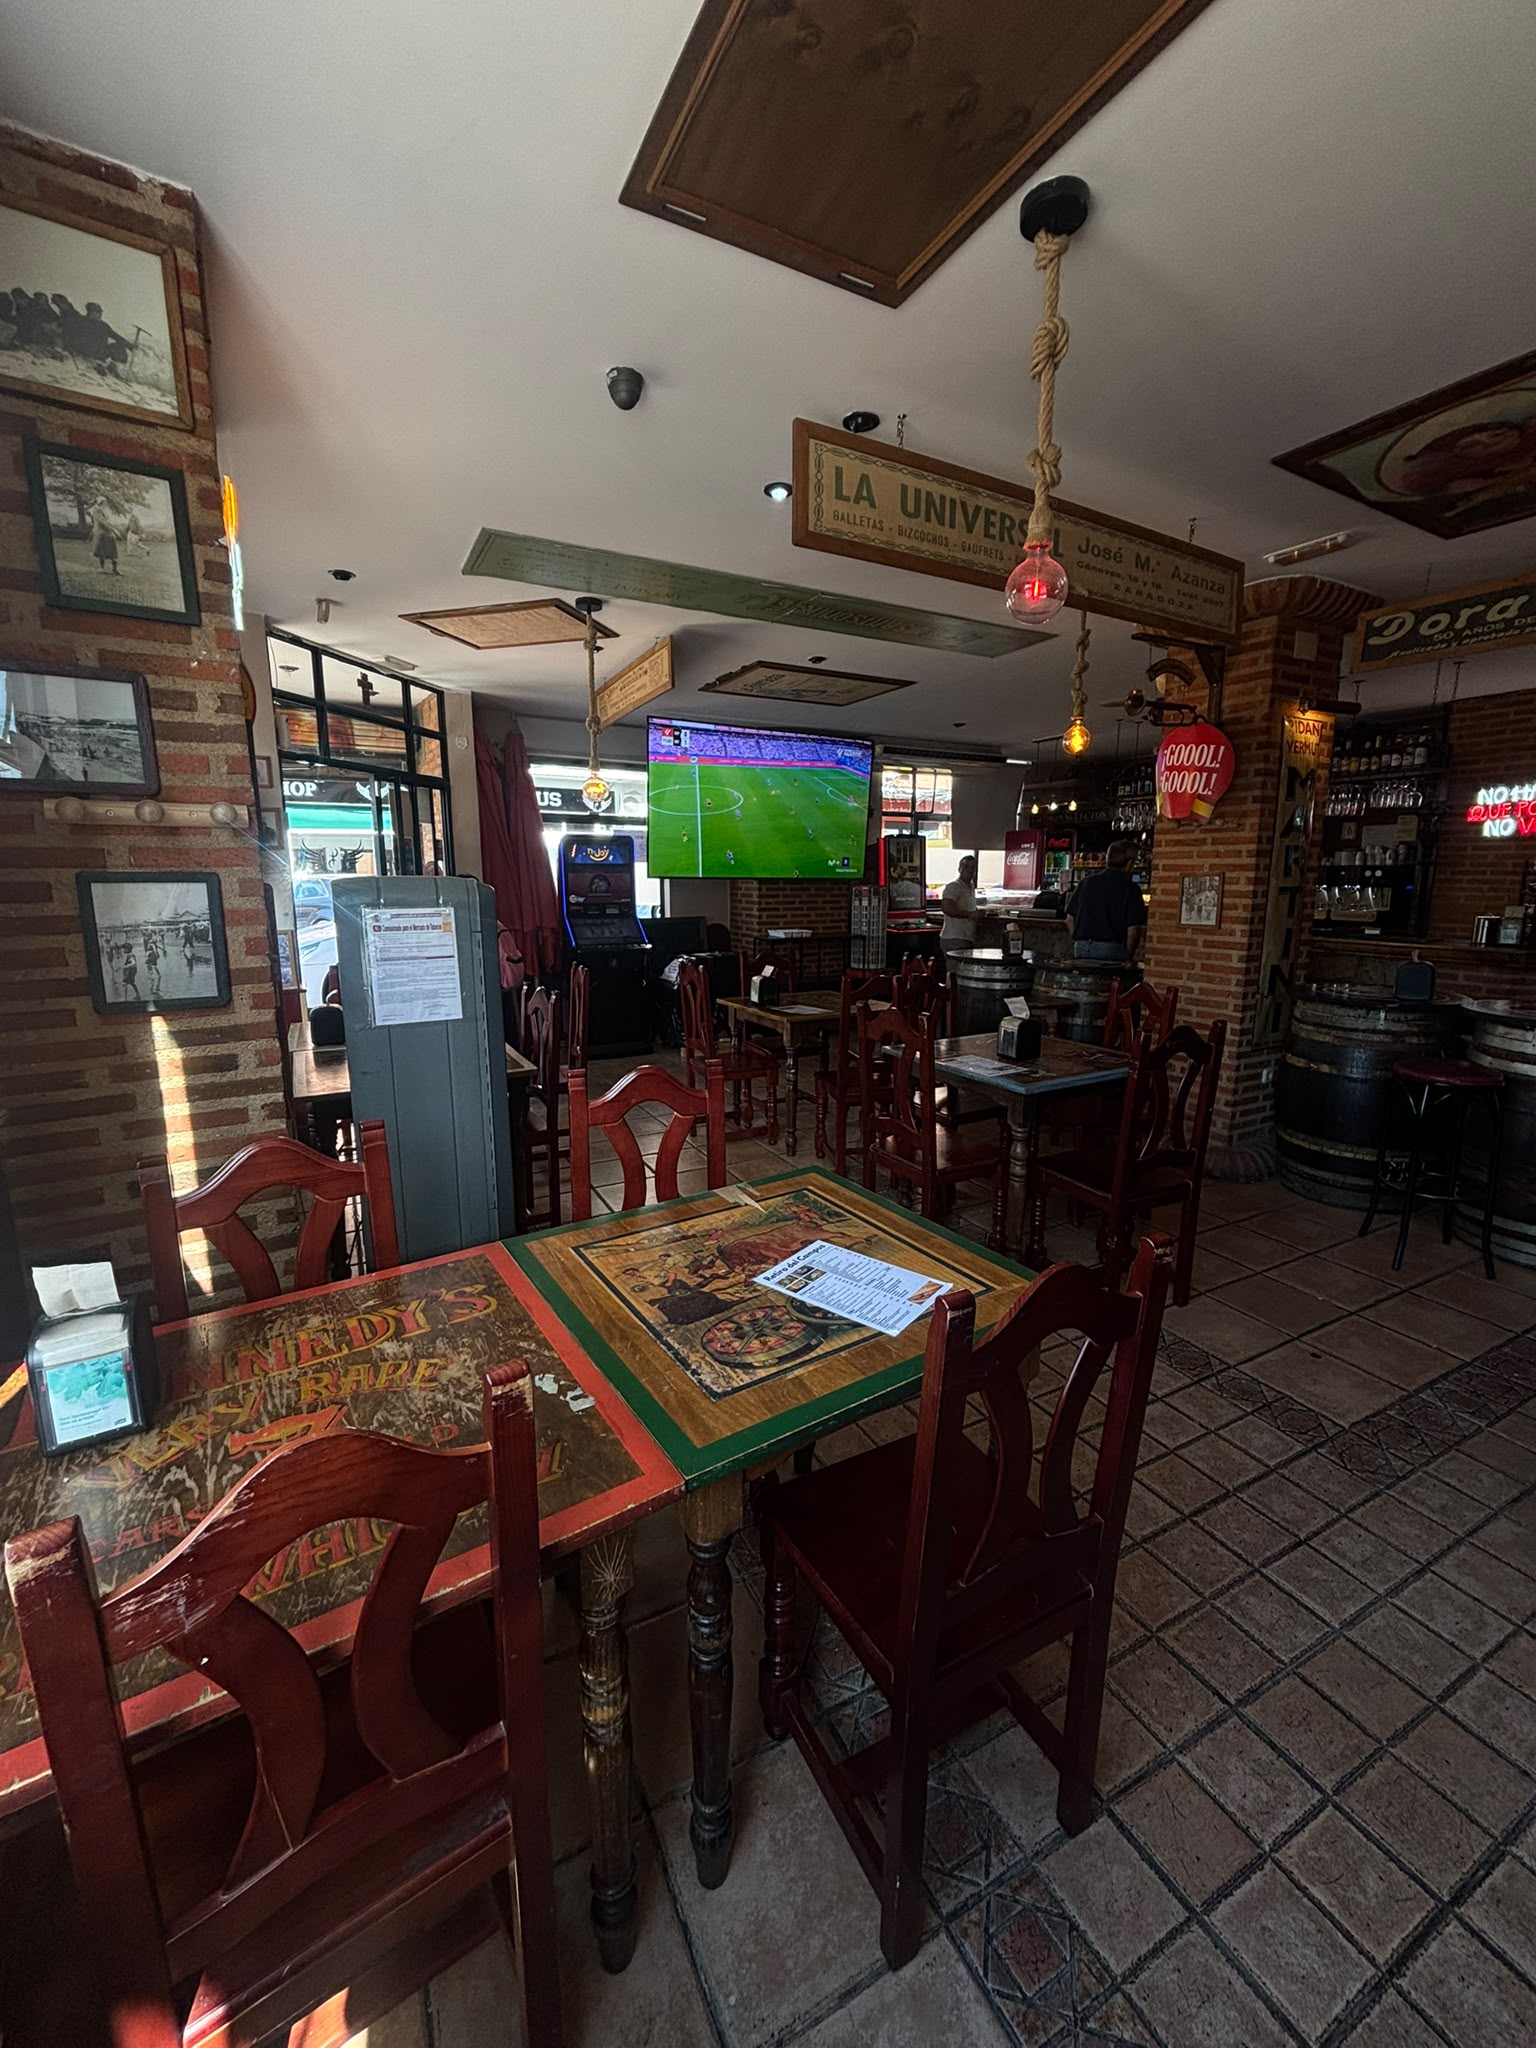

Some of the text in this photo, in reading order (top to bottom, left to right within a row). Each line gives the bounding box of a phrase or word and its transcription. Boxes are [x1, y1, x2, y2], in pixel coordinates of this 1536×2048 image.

[834, 465, 1064, 558] LA UNIVERSL
[833, 509, 885, 531] GALLETAS
[961, 540, 1004, 561] GAUFRETS
[1077, 536, 1123, 564] José
[1171, 565, 1225, 595] Azanza
[1367, 594, 1530, 645] Dora
[1162, 743, 1225, 771] ¡GOOOL!
[1467, 803, 1512, 822] QUE
[1477, 786, 1509, 806] NO
[1482, 818, 1517, 837] NO
[763, 1243, 826, 1282] Retiro del Campus
